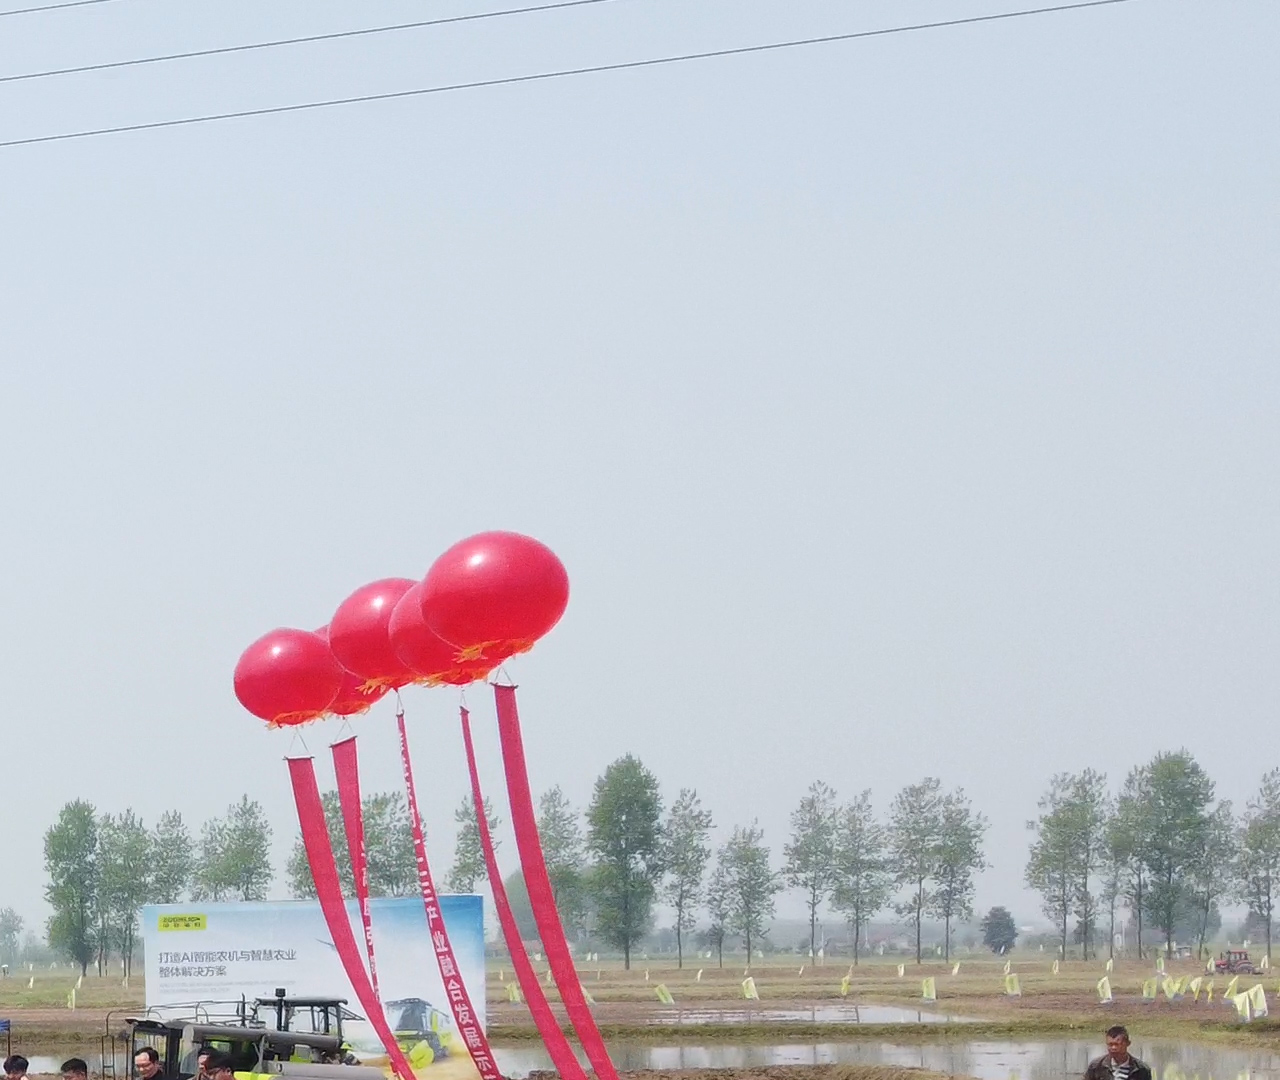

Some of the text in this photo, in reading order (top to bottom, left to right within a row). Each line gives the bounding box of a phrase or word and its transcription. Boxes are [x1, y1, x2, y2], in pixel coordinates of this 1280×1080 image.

[159, 965, 227, 978] 整体解决方案
